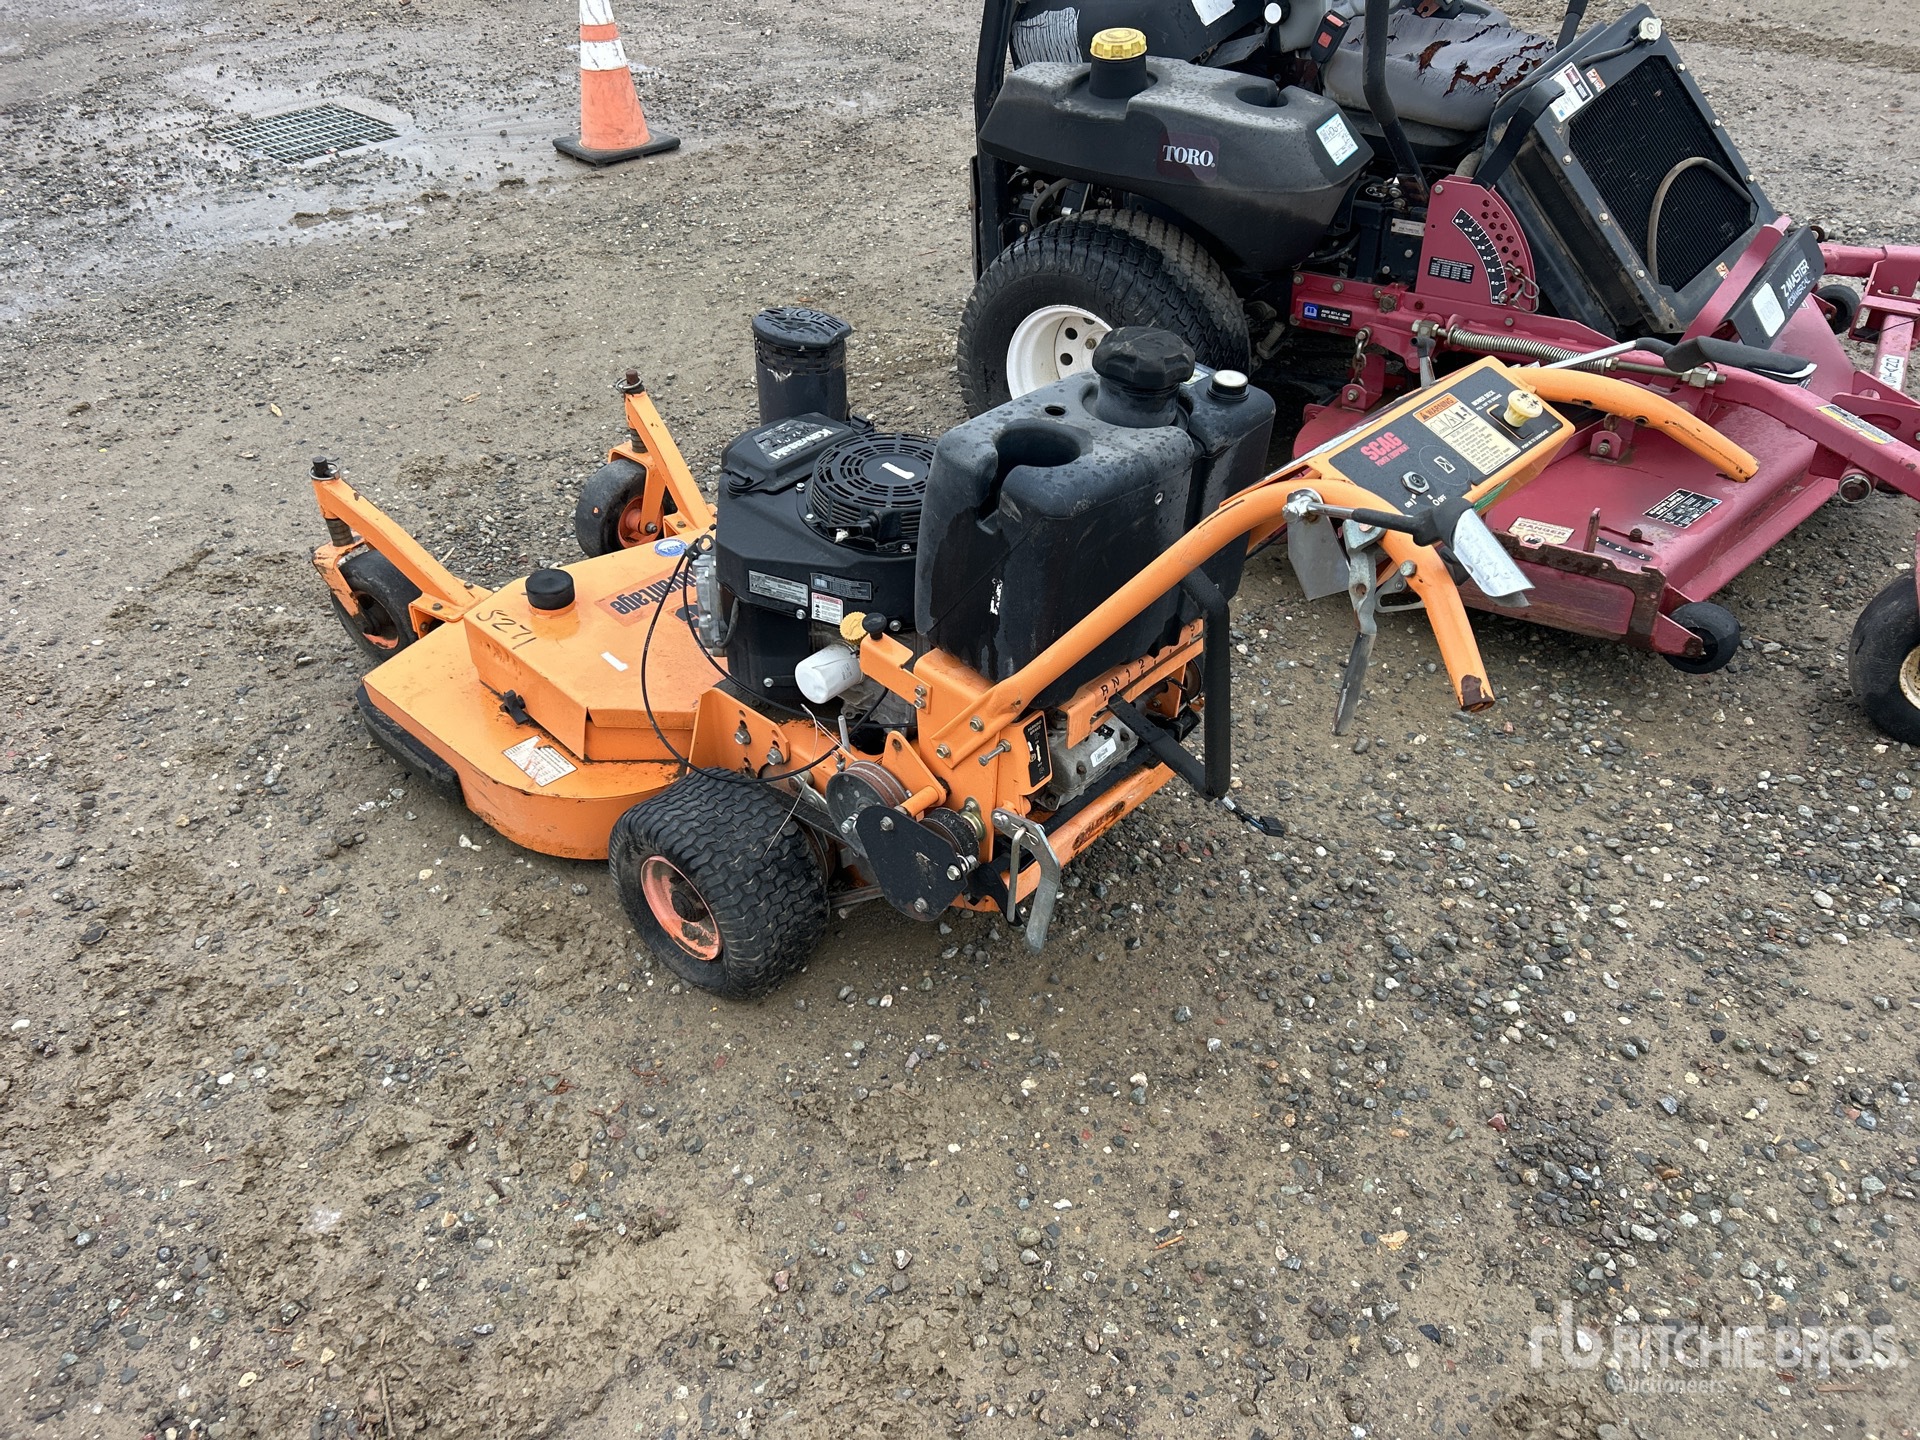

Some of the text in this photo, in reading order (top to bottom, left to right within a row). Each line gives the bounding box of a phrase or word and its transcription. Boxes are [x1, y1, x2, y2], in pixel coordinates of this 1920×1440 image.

[1162, 144, 1214, 168] TORO
[1781, 258, 1810, 297] Z MASTER
[1427, 398, 1454, 415] WARNING
[768, 428, 833, 459] Kawasaki
[1360, 432, 1402, 460] SCAG
[1516, 522, 1569, 536] DANGER
[1138, 659, 1145, 669] 2
